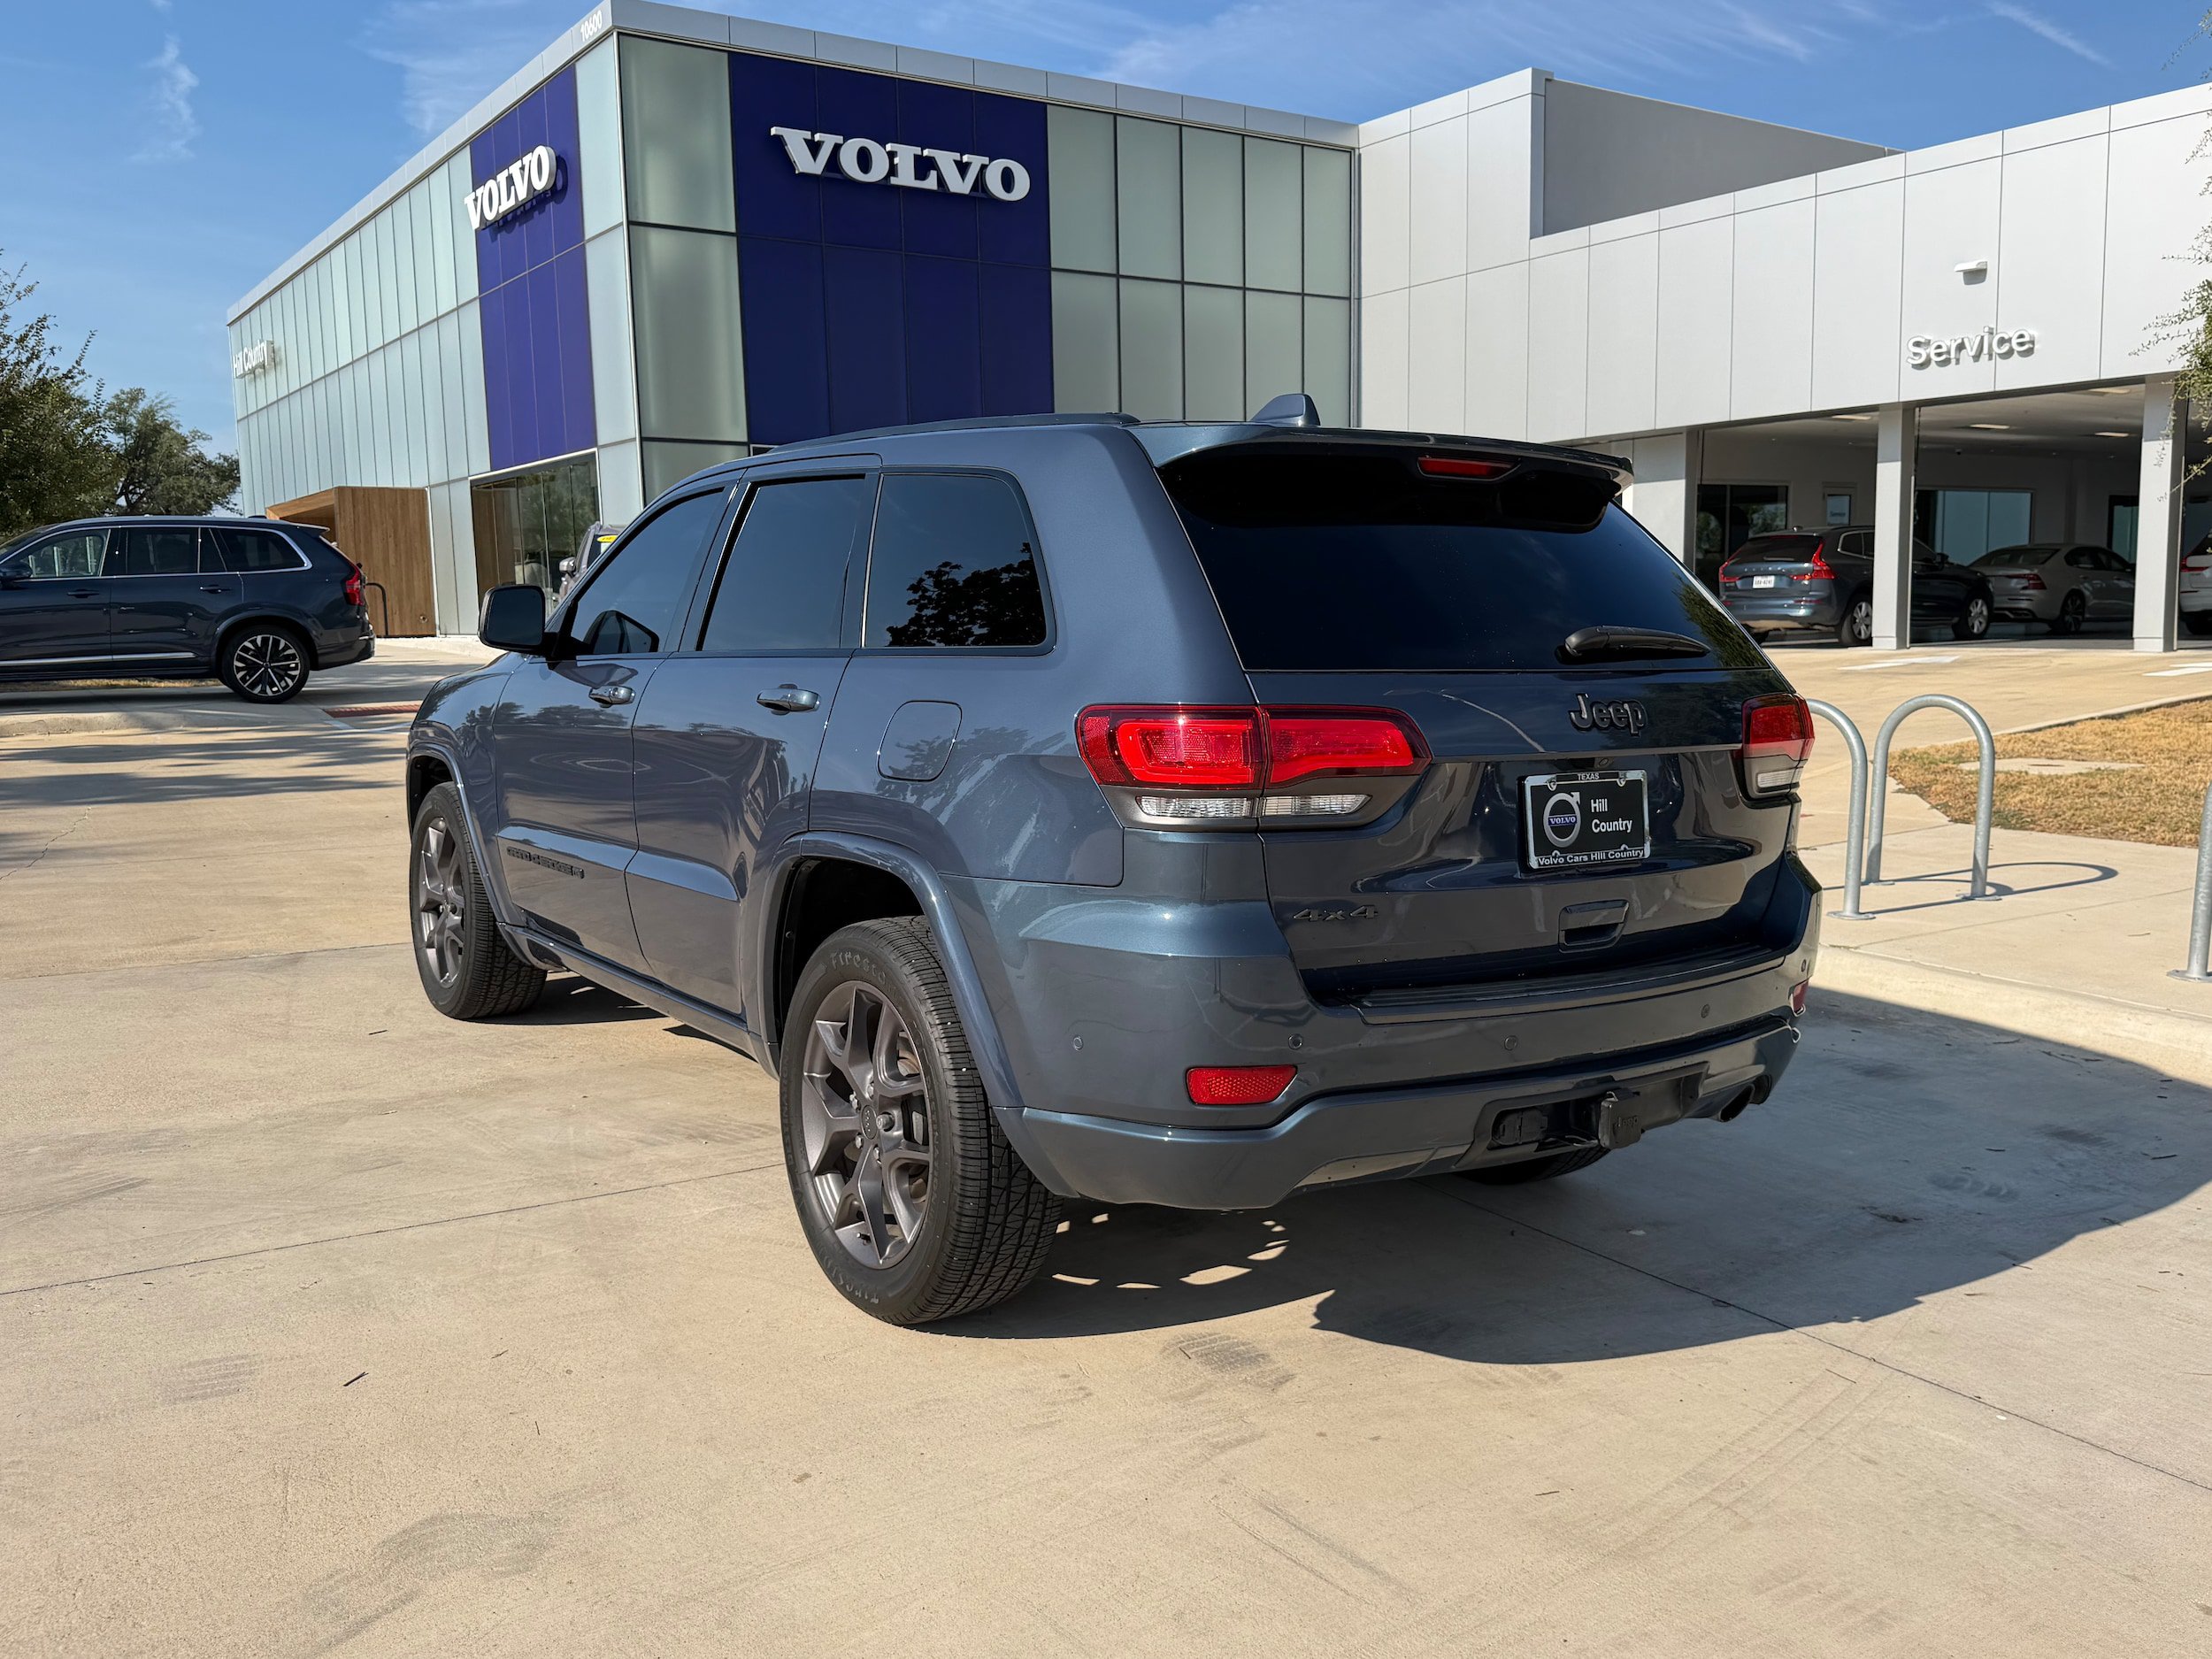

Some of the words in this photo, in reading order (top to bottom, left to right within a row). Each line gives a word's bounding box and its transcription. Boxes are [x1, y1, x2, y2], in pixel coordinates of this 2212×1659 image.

[580, 10, 603, 42] 10600
[769, 126, 1031, 202] VOLVO
[465, 145, 557, 231] VOLVO
[1907, 326, 2036, 365] Service
[1568, 693, 1648, 736] Jeep
[1577, 772, 1601, 781] TEXAS
[1590, 798, 1609, 813] Hill
[1549, 816, 1577, 825] VOLVO
[1591, 818, 1633, 833] Country
[1538, 856, 1565, 865] Volvo
[1566, 854, 1589, 863] Cars
[1590, 852, 1607, 861] Hill
[1607, 849, 1644, 860] Country
[1293, 904, 1379, 922] 4x4
